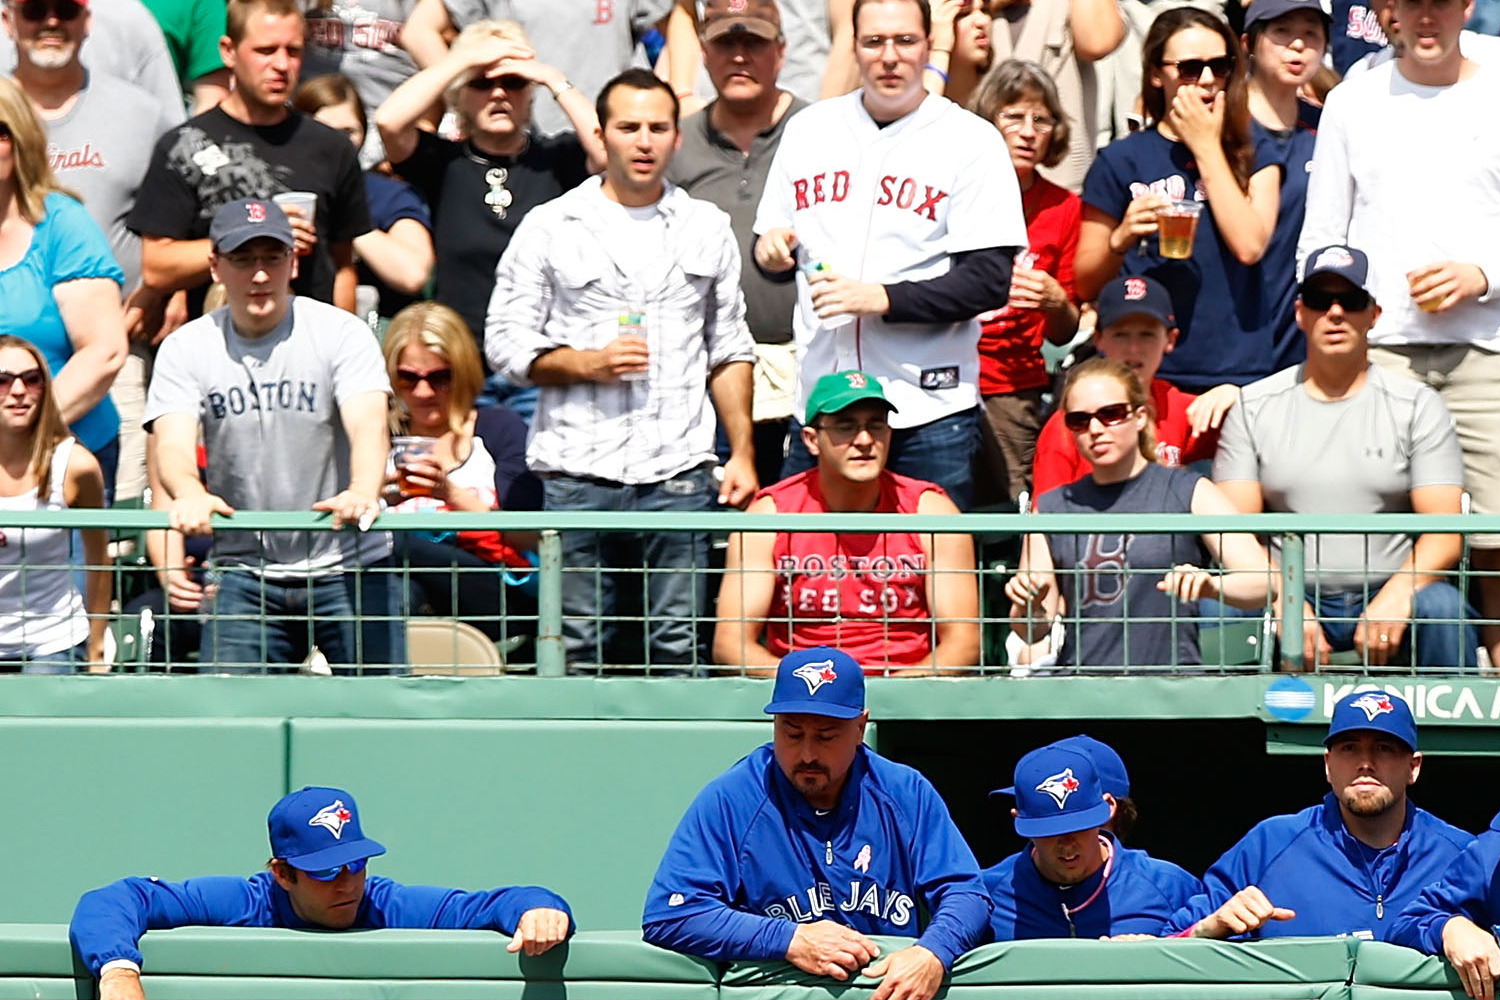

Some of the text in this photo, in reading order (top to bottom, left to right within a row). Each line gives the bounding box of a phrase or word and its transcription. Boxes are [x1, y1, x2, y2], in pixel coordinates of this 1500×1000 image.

[47, 142, 105, 171] inals
[246, 202, 266, 223] B
[793, 170, 948, 222] RED SOX
[1124, 277, 1147, 300] B
[208, 380, 317, 419] BOSTON
[777, 553, 925, 582] BOSTON
[1078, 533, 1135, 610] B
[1323, 683, 1485, 719] KNICA
[764, 881, 914, 926] BLUE JAYS
